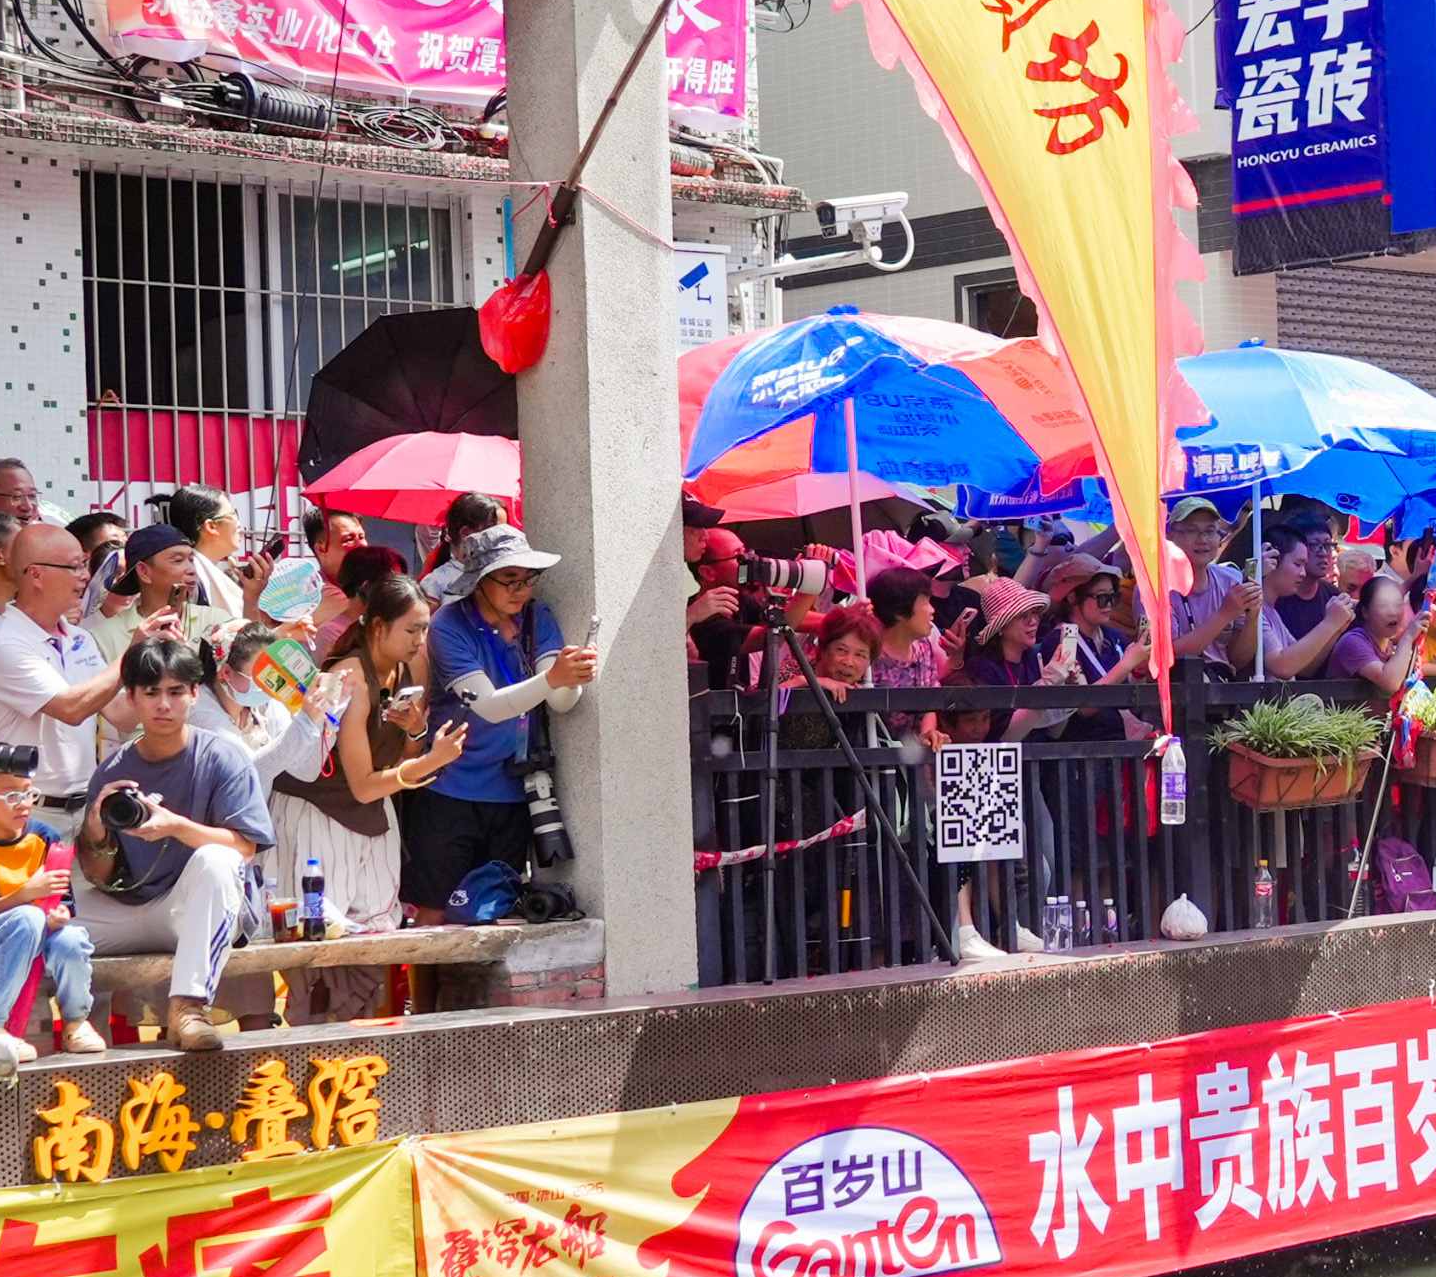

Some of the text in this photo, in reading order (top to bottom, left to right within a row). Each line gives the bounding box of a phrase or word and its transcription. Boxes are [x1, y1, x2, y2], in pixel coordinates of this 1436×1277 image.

[1235, 42, 1373, 142] 瓷砖
[1237, 134, 1377, 170] HONGYU CERAMICS
[780, 1146, 926, 1218] 百岁山
